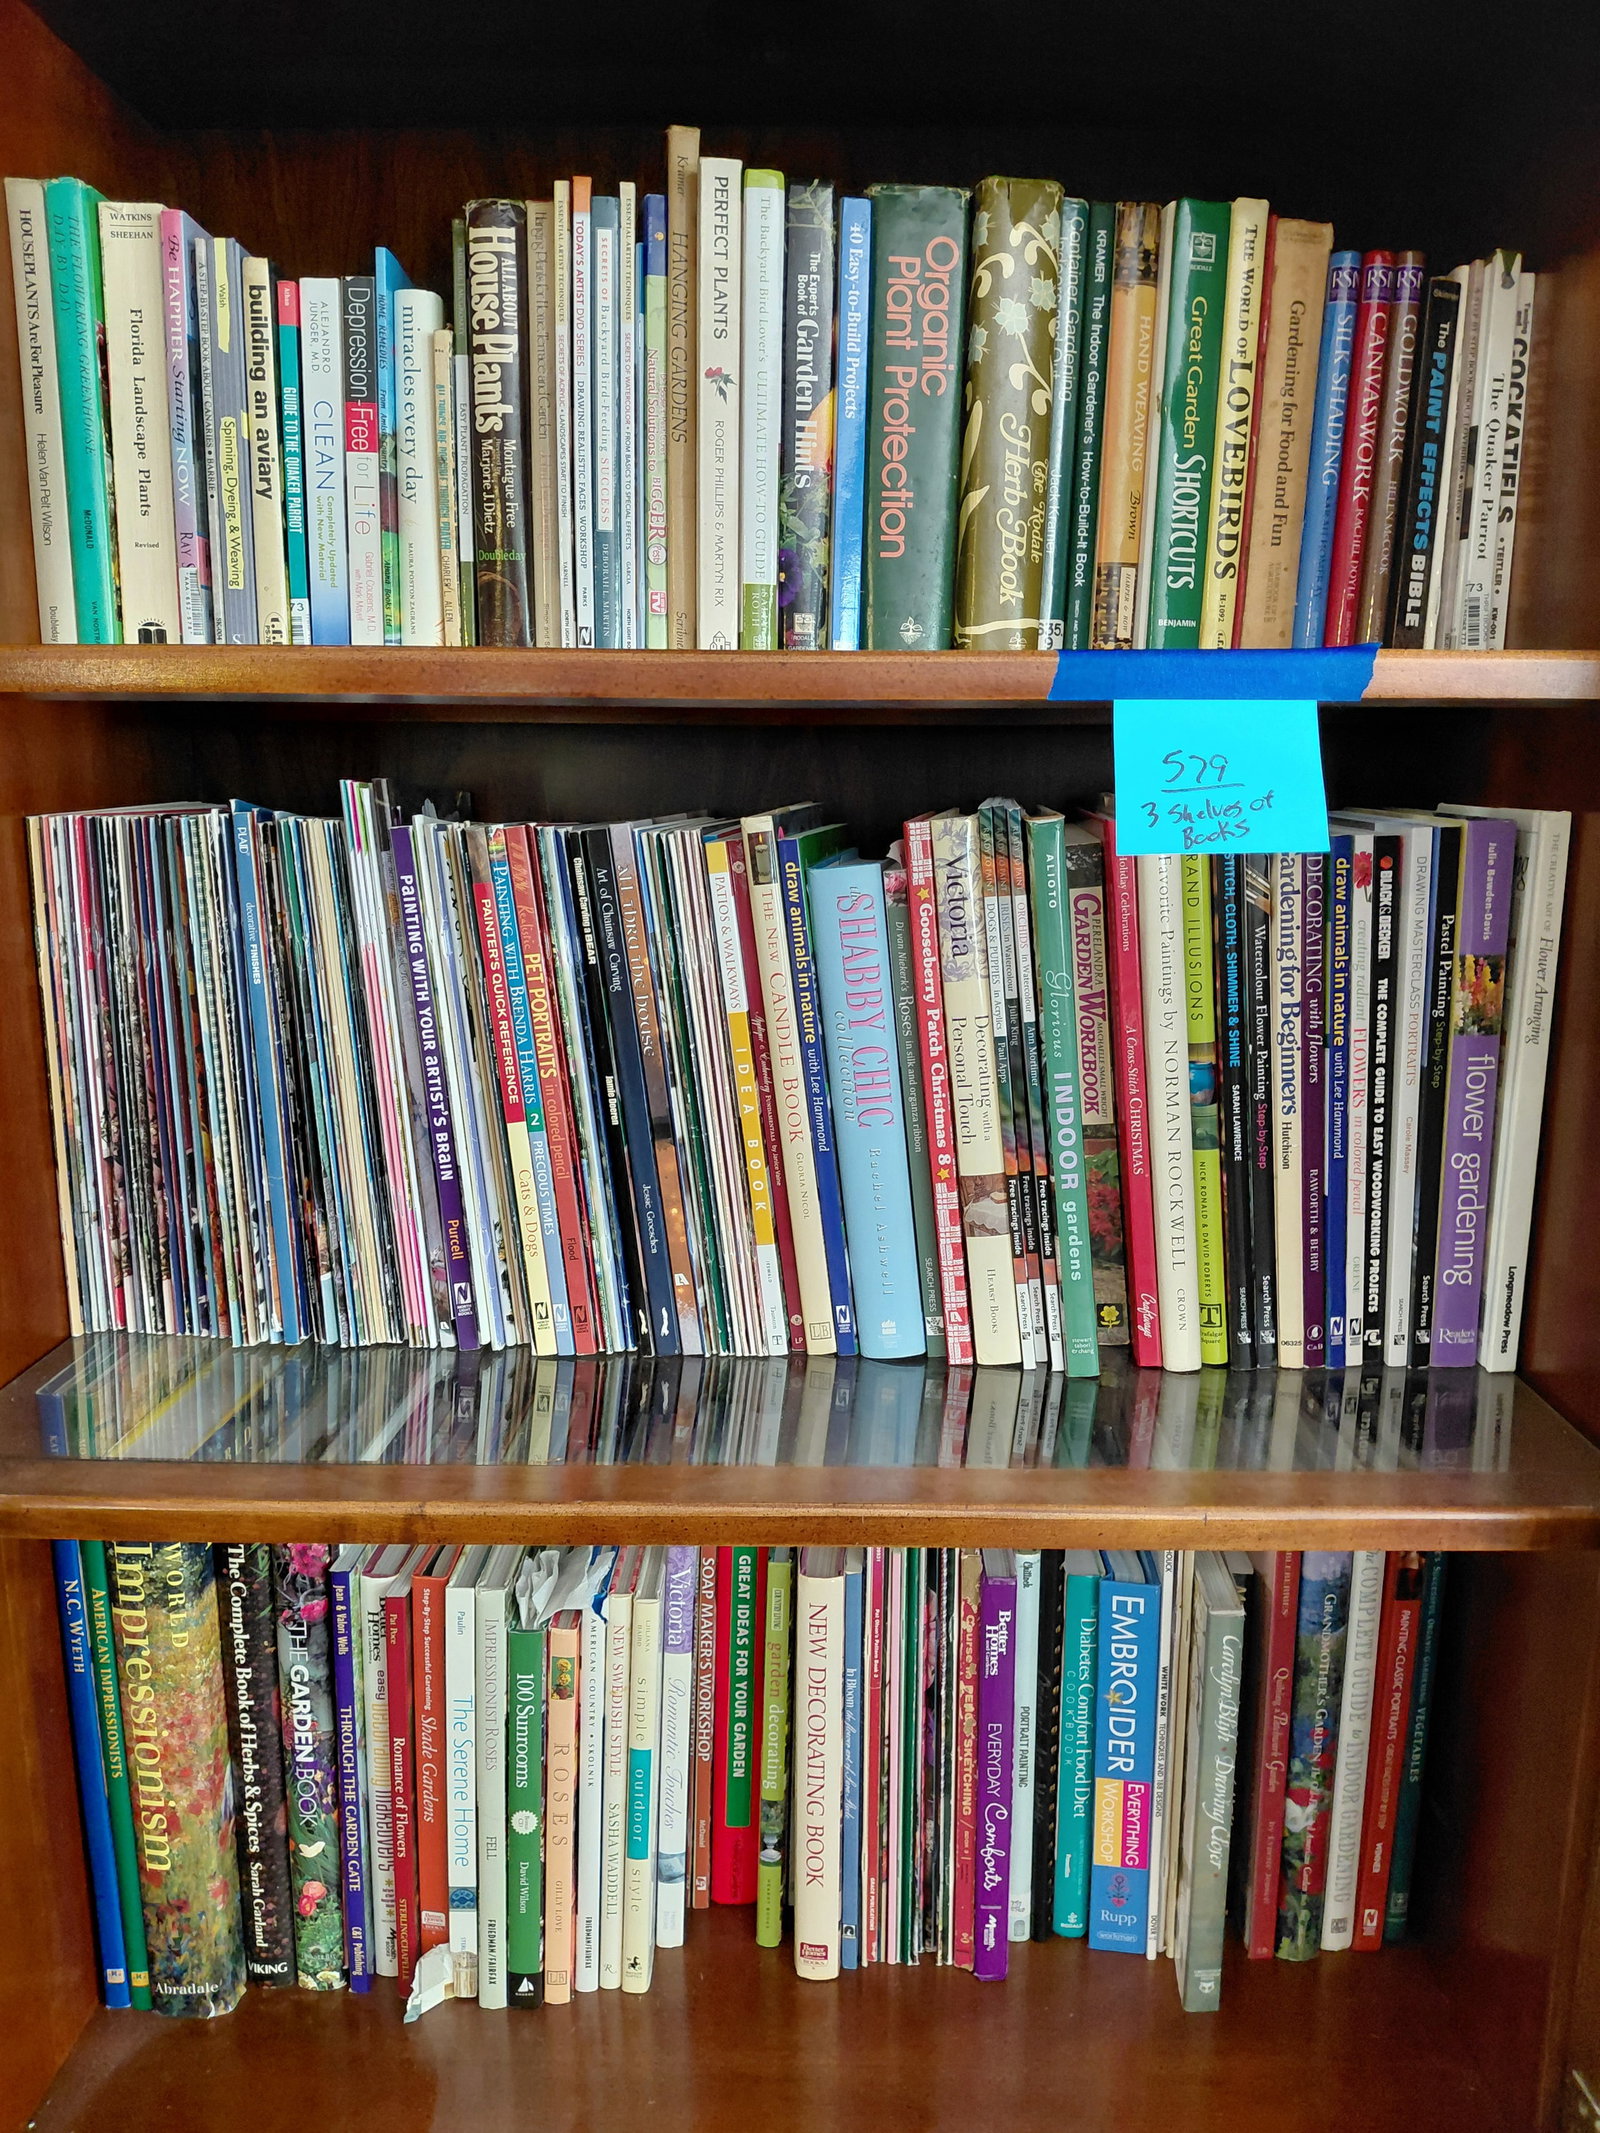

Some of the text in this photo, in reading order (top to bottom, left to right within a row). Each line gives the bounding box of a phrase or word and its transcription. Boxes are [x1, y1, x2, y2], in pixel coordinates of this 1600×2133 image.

[110, 213, 152, 221] WATKINS
[110, 231, 153, 239] SHEEHAN
[713, 176, 729, 340] PERFECT PLANTS
[19, 209, 44, 415] HOUSEPLANTS Are For Pleasure
[168, 234, 190, 506] Be HAPPIER Starting NOW
[469, 227, 518, 433] House Plants
[671, 232, 688, 444] HANGING GARDENS
[842, 223, 864, 420] 40 Easy-to-Build Projects
[917, 235, 960, 397] Organic
[1388, 314, 1417, 463] GOLDWORK
[1438, 322, 1450, 348] The
[130, 308, 151, 517] Florida Landscape Plants
[248, 285, 274, 500] building an aviary
[284, 387, 303, 534] GUIDE TO THE QUAKER PARROT
[313, 401, 336, 489] CLEAN
[348, 288, 375, 535] Depression-Free for Life
[401, 305, 423, 504] miracles every day
[879, 256, 921, 558] Plant Protection
[1214, 224, 1258, 580] THE WORLD OF LOVEBIRDS
[1322, 315, 1353, 487] SILK SHADING
[1352, 312, 1387, 502] CANVASWORK
[1426, 351, 1447, 434] PAINT
[135, 541, 160, 549] Revised
[224, 421, 241, 587] Spinning, Dyeing, & Weaving
[996, 412, 1032, 606] Herb Book
[1167, 453, 1207, 590] SHORTCUTS
[1413, 442, 1439, 550] EFFECTS
[1158, 619, 1197, 628] BENJAMIN
[1405, 554, 1426, 628] BIBLE
[1045, 853, 1057, 909] ALIOTO
[1141, 802, 1159, 828] 3
[1168, 799, 1243, 824] Shelves
[1182, 819, 1250, 850] Books
[250, 943, 261, 985] FINISHES
[714, 876, 741, 1009] PATIOS & WALKWAYS
[785, 861, 816, 1044] draw animals in nature
[944, 855, 975, 959] Victoria
[1305, 855, 1323, 993] DECORATING
[481, 899, 519, 1105] PAINTER'S QUICK REFERENCE
[493, 866, 540, 1126] PAINTING WITH BRENDA HARRIS 2
[523, 953, 557, 1079] PET PORTRAITS
[769, 971, 804, 1144] CANDLE BOOK
[837, 893, 895, 1129] SHABBY CHIC
[919, 903, 951, 1166] Gooseberry Patch Christmas 8
[1226, 952, 1241, 1068] SHIMMER & SHINE
[1276, 1000, 1302, 1116] Beginners
[518, 1169, 539, 1258] Cats & Dogs
[1053, 1072, 1083, 1281] INDOOR gardens
[1129, 1098, 1144, 1176] CHRISTMAS
[1164, 1039, 1186, 1271] NORMAN ROCKWELL
[1442, 1053, 1496, 1286] flower gardening
[448, 1219, 465, 1260] Purcell
[1367, 1157, 1384, 1313] WOODWORKING PROJECTS
[1500, 1265, 1517, 1354] Longmeadow Press
[64, 1579, 85, 1674] N.C. WYETH
[91, 1587, 123, 1779] AMERICAN IMPRESSIONISTS
[668, 1567, 692, 1646] Victoria
[698, 1557, 715, 1762] SOAP MAKER'S WORKSHOP
[733, 1555, 752, 1778] GREAT IDEAS FOR YOUR GARDEN
[112, 1541, 176, 1871] Impressionism
[515, 1672, 535, 1788] 100 Sunrooms
[610, 1625, 625, 1778] NEW SWEDISH STYLE
[805, 1602, 828, 1888] NEW DECORATING BOOK
[1107, 1595, 1145, 1773] EMBROIDER
[453, 1695, 474, 1867] The Serene Home
[980, 1723, 1009, 1892] EVERYDAY Comforts
[1100, 1782, 1121, 1863] WORKSHOP
[1121, 1782, 1145, 1866] EVERYTHING
[248, 1961, 288, 1974] VIKING
[249, 1862, 268, 1947] Sarah Garland
[1100, 1909, 1137, 1926] Rupp
[155, 1981, 219, 1995] Abradale
